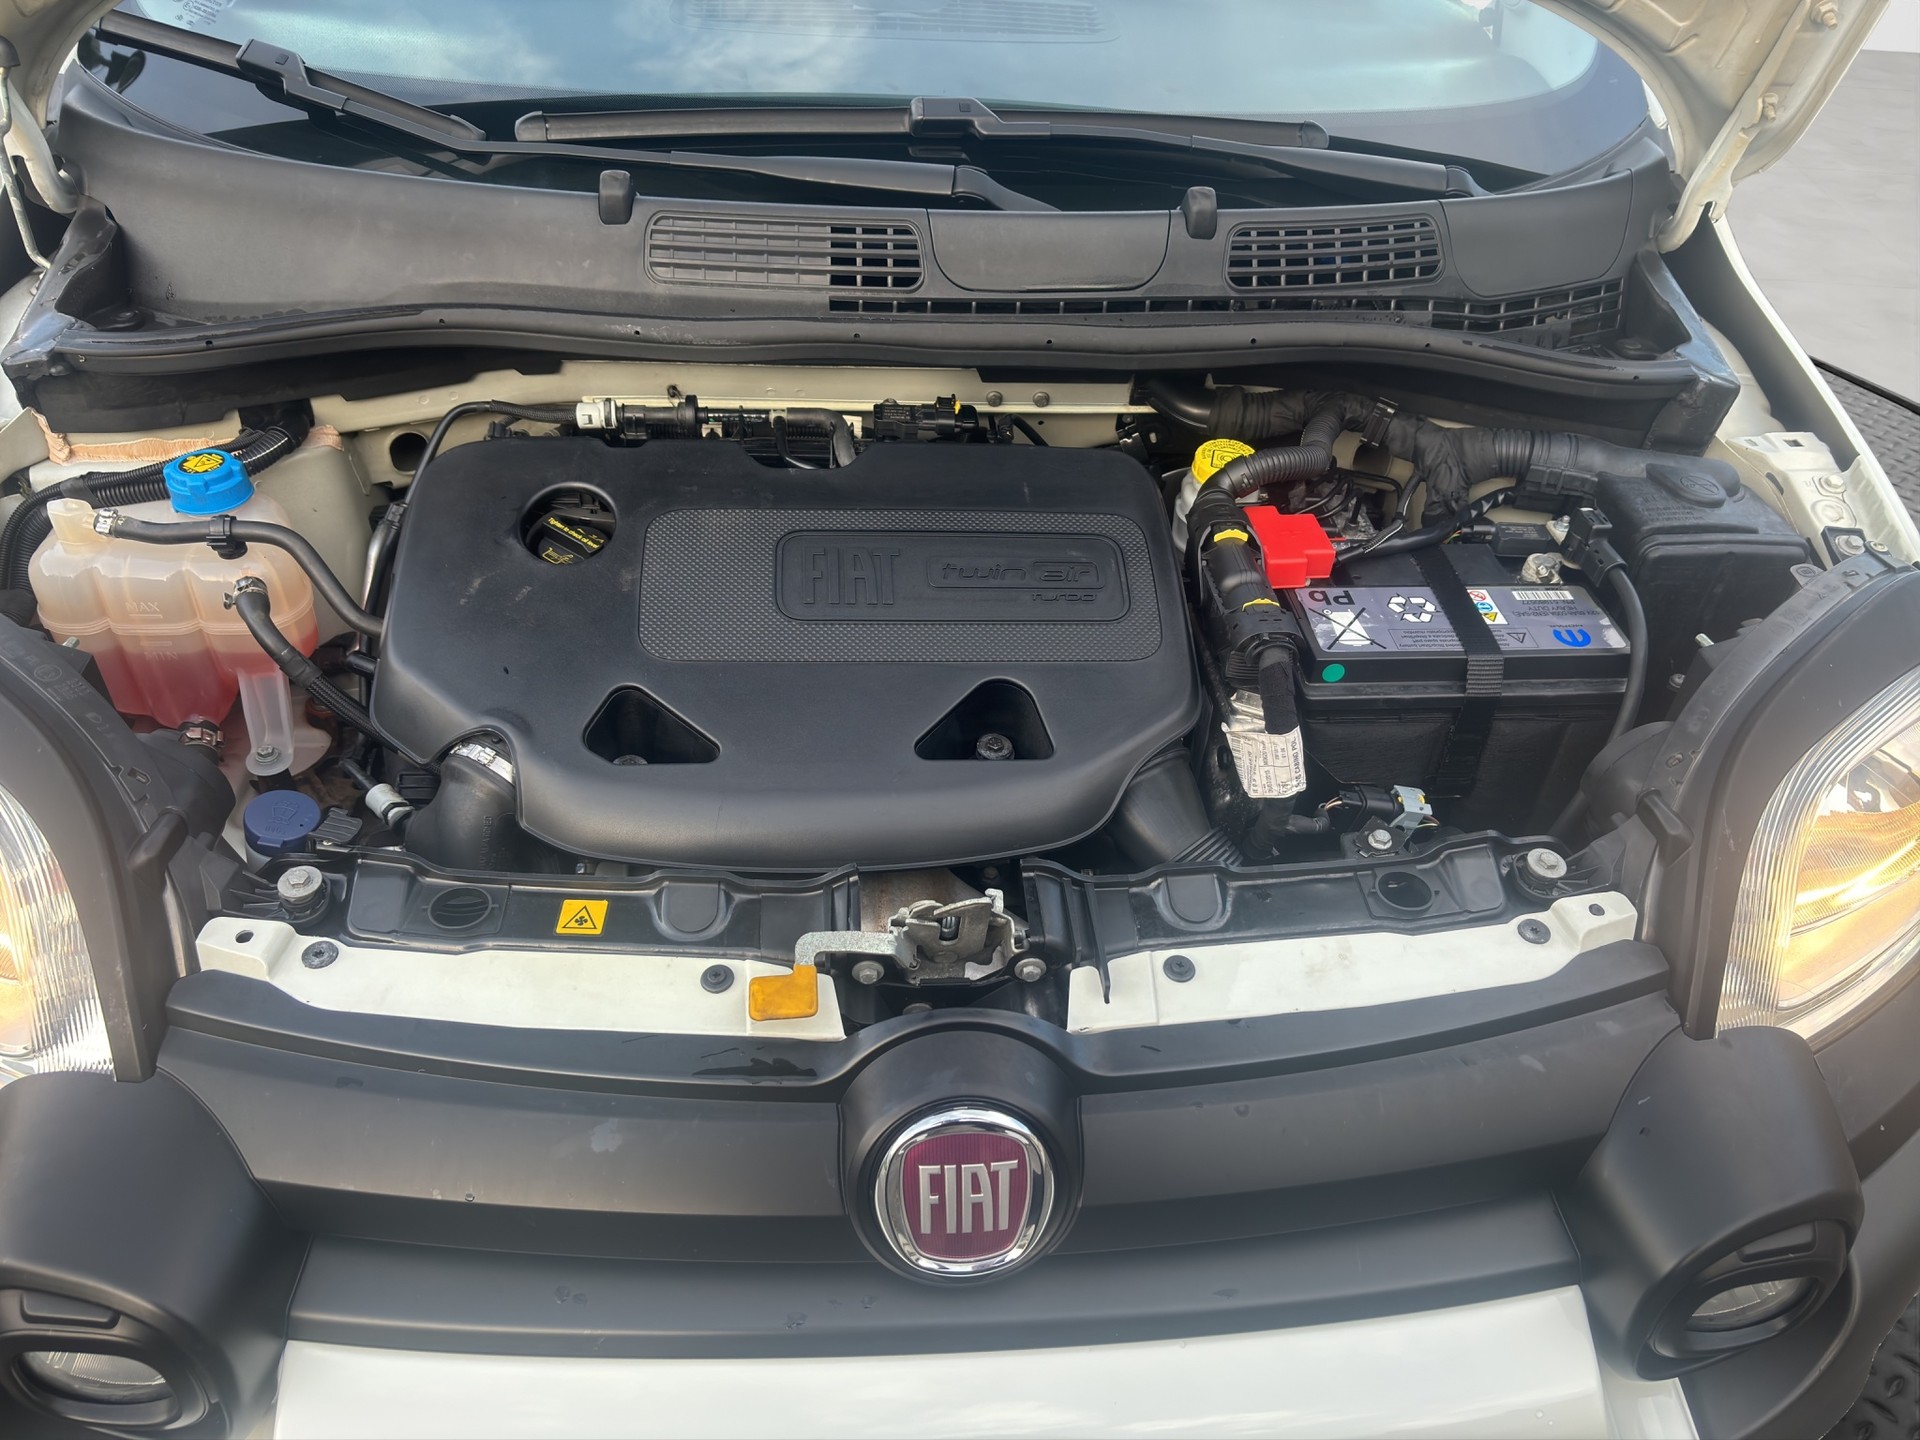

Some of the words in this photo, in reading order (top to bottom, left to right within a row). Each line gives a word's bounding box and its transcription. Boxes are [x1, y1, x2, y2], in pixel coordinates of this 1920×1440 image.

[803, 547, 899, 606] FIAT
[941, 562, 1027, 579] twin
[1039, 565, 1092, 583] air
[1031, 592, 1098, 602] turbo
[1308, 590, 1355, 606] Pb
[125, 601, 161, 612] MAX
[143, 651, 178, 661] MIN
[919, 1159, 1019, 1235] FIAT
